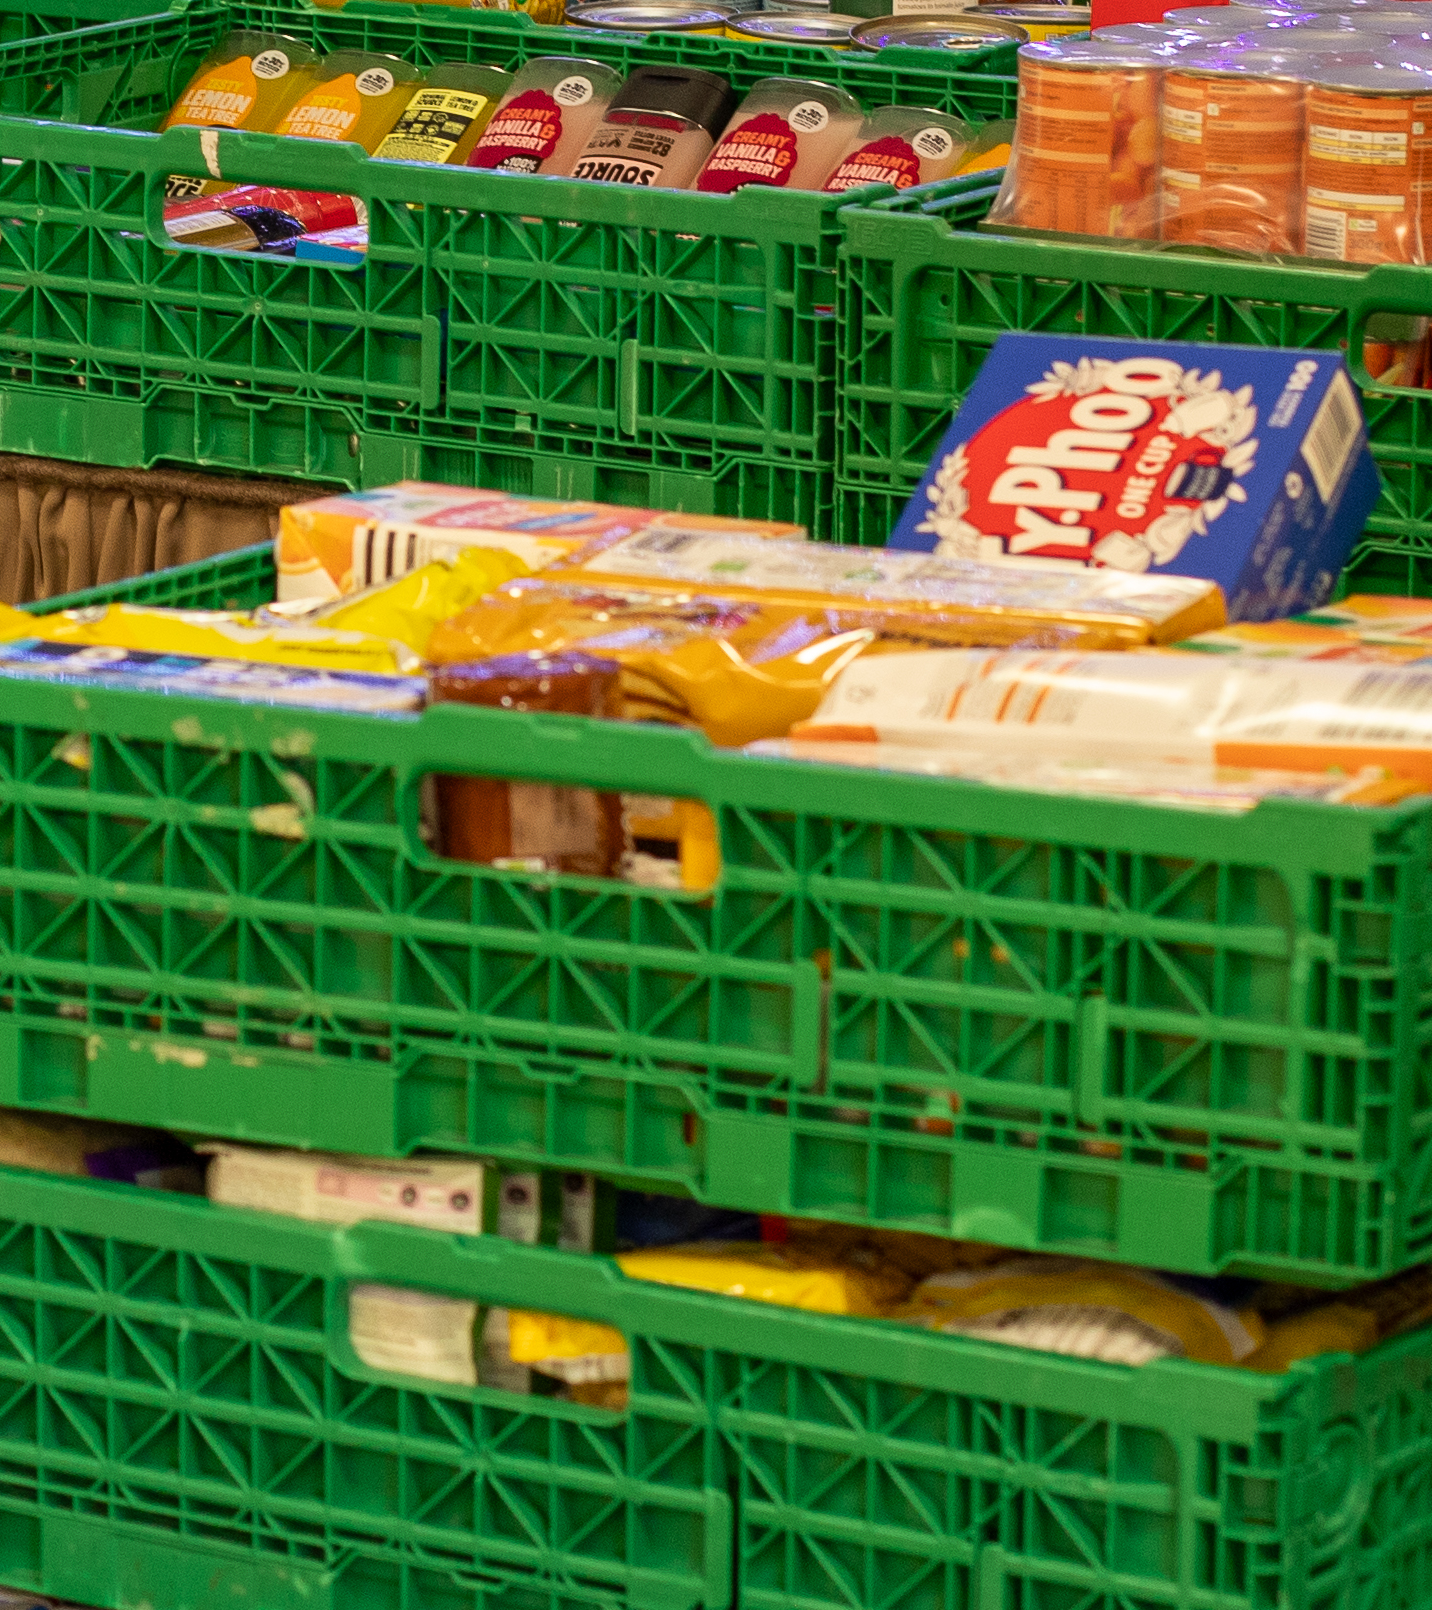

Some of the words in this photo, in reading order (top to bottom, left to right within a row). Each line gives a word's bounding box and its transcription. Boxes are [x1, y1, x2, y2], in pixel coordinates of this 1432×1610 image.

[181, 89, 253, 113] LEMON
[185, 107, 209, 121] TEA
[208, 109, 240, 125] TREE
[285, 105, 357, 130] LEMON
[498, 107, 555, 123] CREAMY
[288, 122, 311, 137] TEA
[310, 125, 344, 141] TREE
[488, 120, 542, 137] VANILLA
[540, 123, 556, 140] &
[732, 131, 792, 149] CREAMY
[476, 136, 549, 152] RASPBERRY
[715, 143, 777, 162] VANILLA
[775, 150, 791, 167] &
[706, 158, 784, 180] RASPBERRY
[853, 152, 915, 171] CREAMY
[573, 159, 658, 187] SOURCE
[837, 163, 900, 185] VANILLA
[895, 173, 914, 189] &
[1135, 434, 1178, 476] CUP
[1116, 475, 1157, 519] ONE
